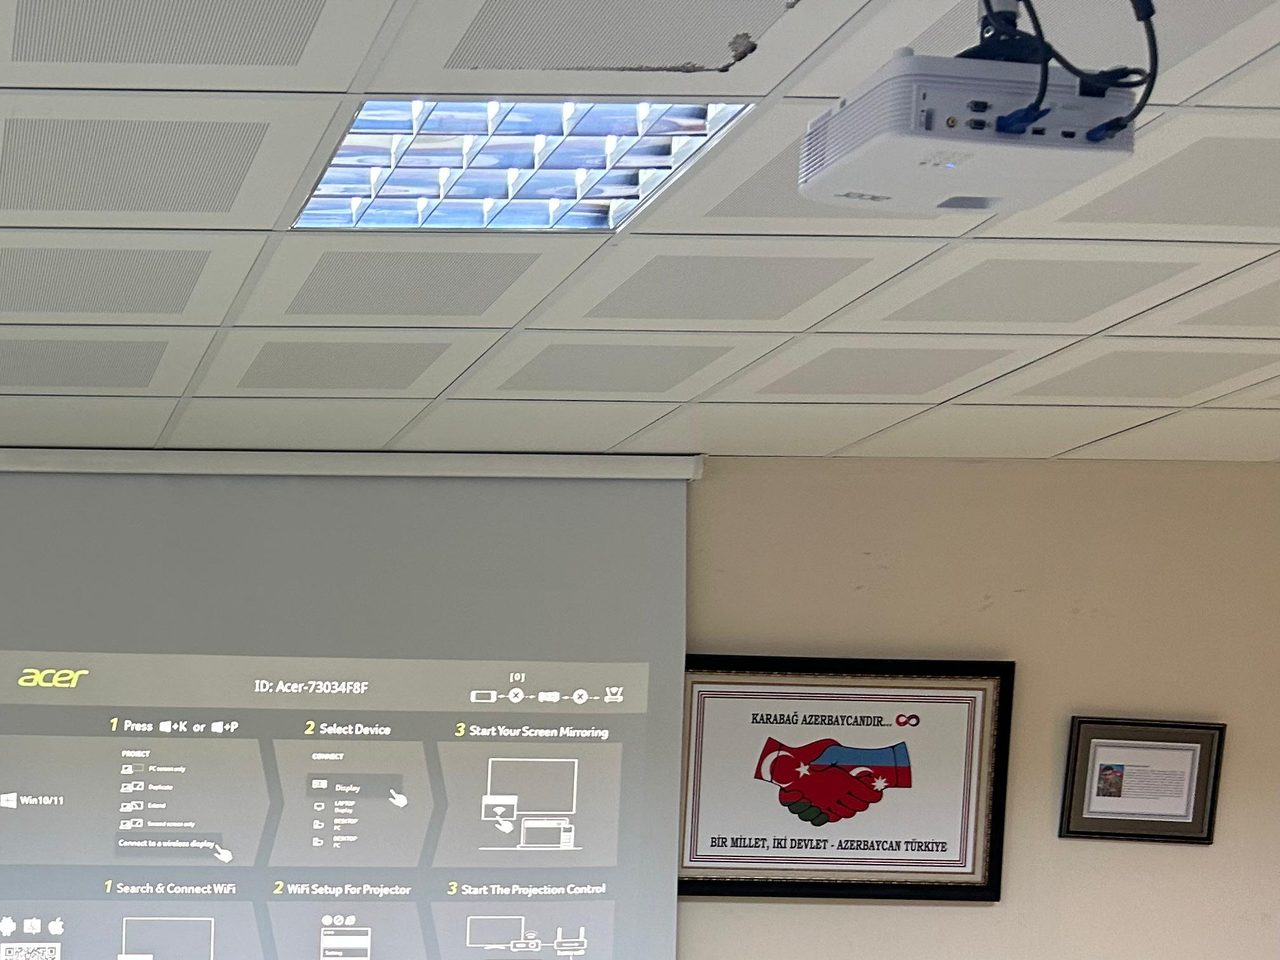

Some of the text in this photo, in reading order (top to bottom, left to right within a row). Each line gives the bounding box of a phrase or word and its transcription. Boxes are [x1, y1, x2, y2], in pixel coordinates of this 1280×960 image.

[17, 667, 89, 689] acer
[254, 679, 369, 694] ID: Acer-73034F8F
[110, 717, 119, 732] 1
[123, 720, 154, 732] Press
[192, 723, 207, 732] or
[751, 711, 892, 727] KARABAĞ AZERBAYCANDIR...
[304, 720, 392, 736] 2 Select Device
[454, 722, 609, 740] 3 Start Your Screen Mirroring
[335, 784, 361, 794] Display
[20, 795, 64, 806] Win10/11
[118, 839, 148, 847] Connect
[189, 840, 215, 849] display
[710, 834, 728, 848] BİR
[730, 834, 770, 851] MİLLET,
[772, 836, 788, 849] İKİ
[789, 838, 828, 850] DEVLET
[836, 839, 902, 851] AZERBAYCAN
[903, 838, 948, 852] TÜRKİYE
[104, 879, 237, 894] 1 Search & Connect WiFi
[272, 880, 412, 897] 2 WiFi Setup For Projector
[447, 880, 607, 898] 3 Start The Projection Control
